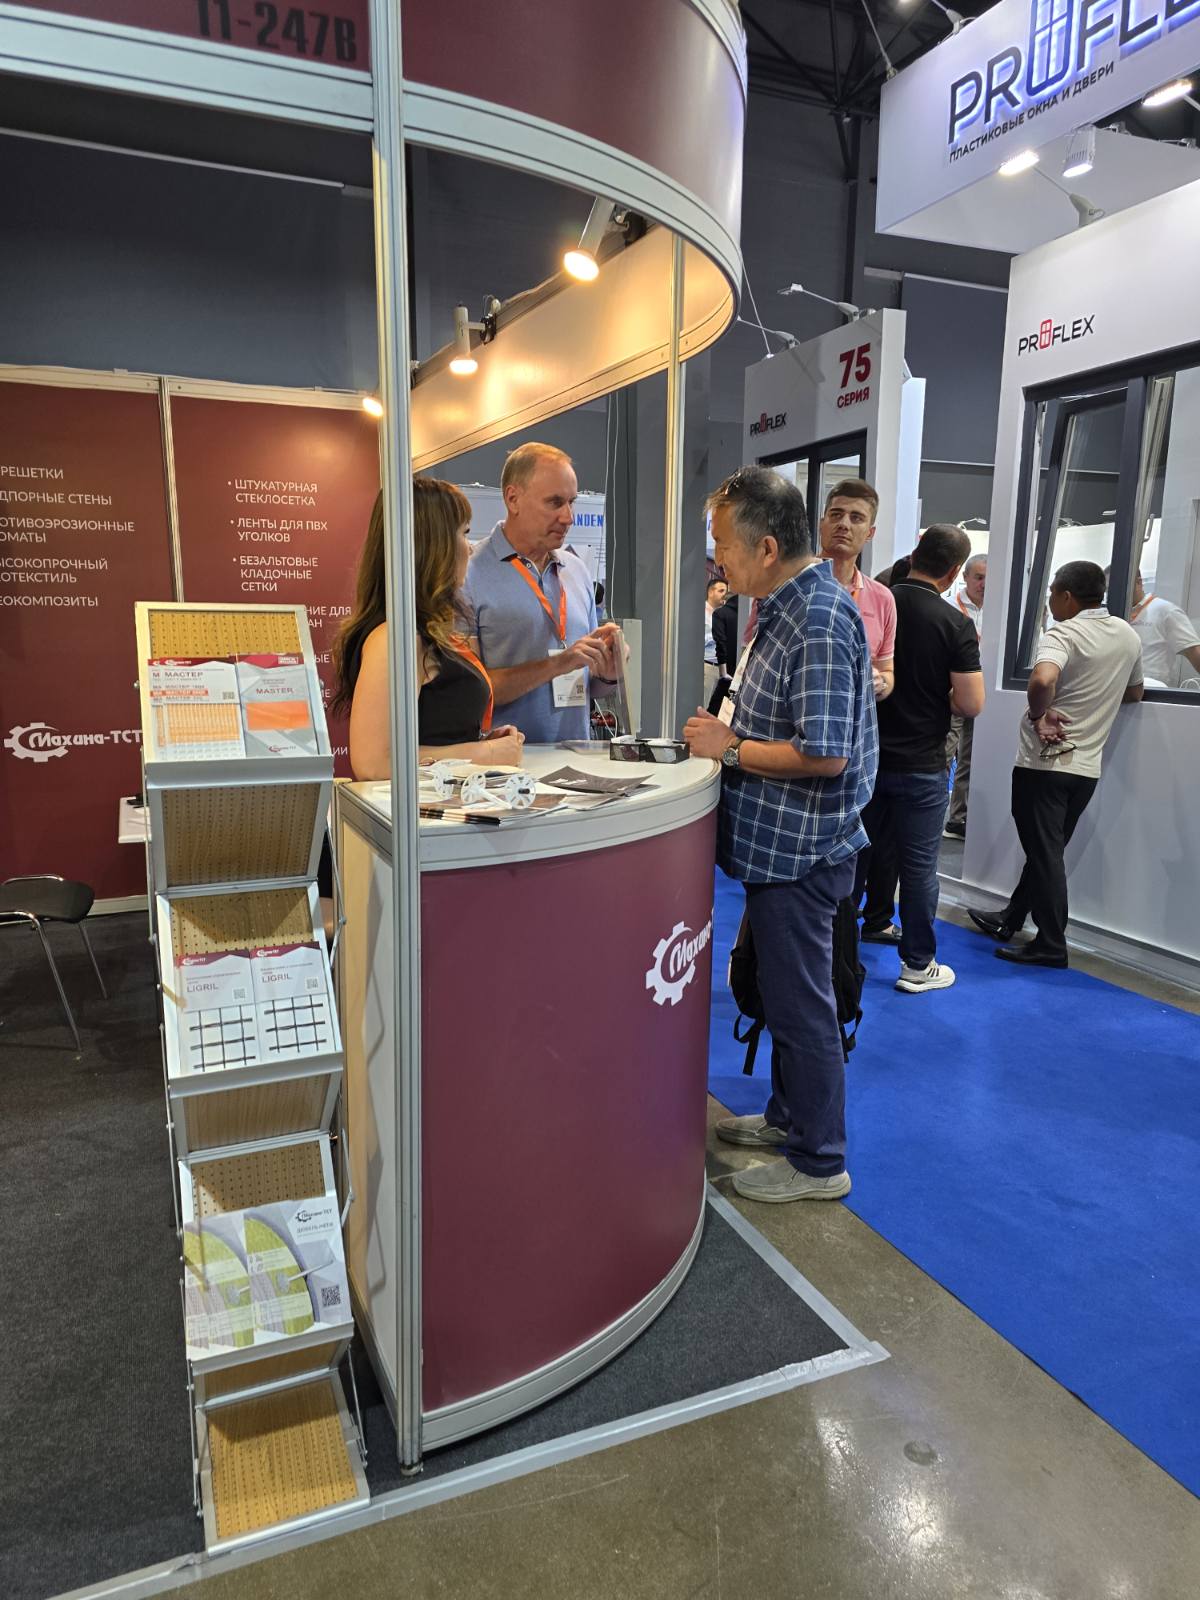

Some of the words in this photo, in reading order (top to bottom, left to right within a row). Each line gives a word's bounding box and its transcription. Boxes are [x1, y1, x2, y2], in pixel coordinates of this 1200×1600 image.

[948, 0, 1200, 145] PROFL
[949, 113, 1025, 163] ПЛАСТИКОВЫЕ
[1027, 95, 1059, 120] ОКНА
[1061, 86, 1071, 102] И
[1072, 61, 1115, 98] ДВЕРИ
[839, 342, 872, 389] 75
[836, 386, 871, 409] СЕРИЯ
[0, 465, 64, 480] РЕШЕТКИ
[234, 479, 318, 493] ШТУКАТУРНАЯ
[68, 493, 112, 506] СТЕНЫ
[235, 492, 316, 506] СТЕКЛОСЕТКА
[237, 517, 277, 529] ЛЕНТЫ
[279, 519, 304, 531] ДЛЯ
[306, 520, 328, 531] ПВХ
[237, 531, 291, 543] УГОЛКОВ
[239, 555, 319, 567] БЕЗАЛЬТОВЫЕ
[0, 571, 77, 583] ОТЕКСТИЛЬ
[240, 568, 313, 580] КЛАДОЧНЫЕ
[241, 581, 278, 592] СЕТКИ
[329, 606, 352, 618] ДЛЯ
